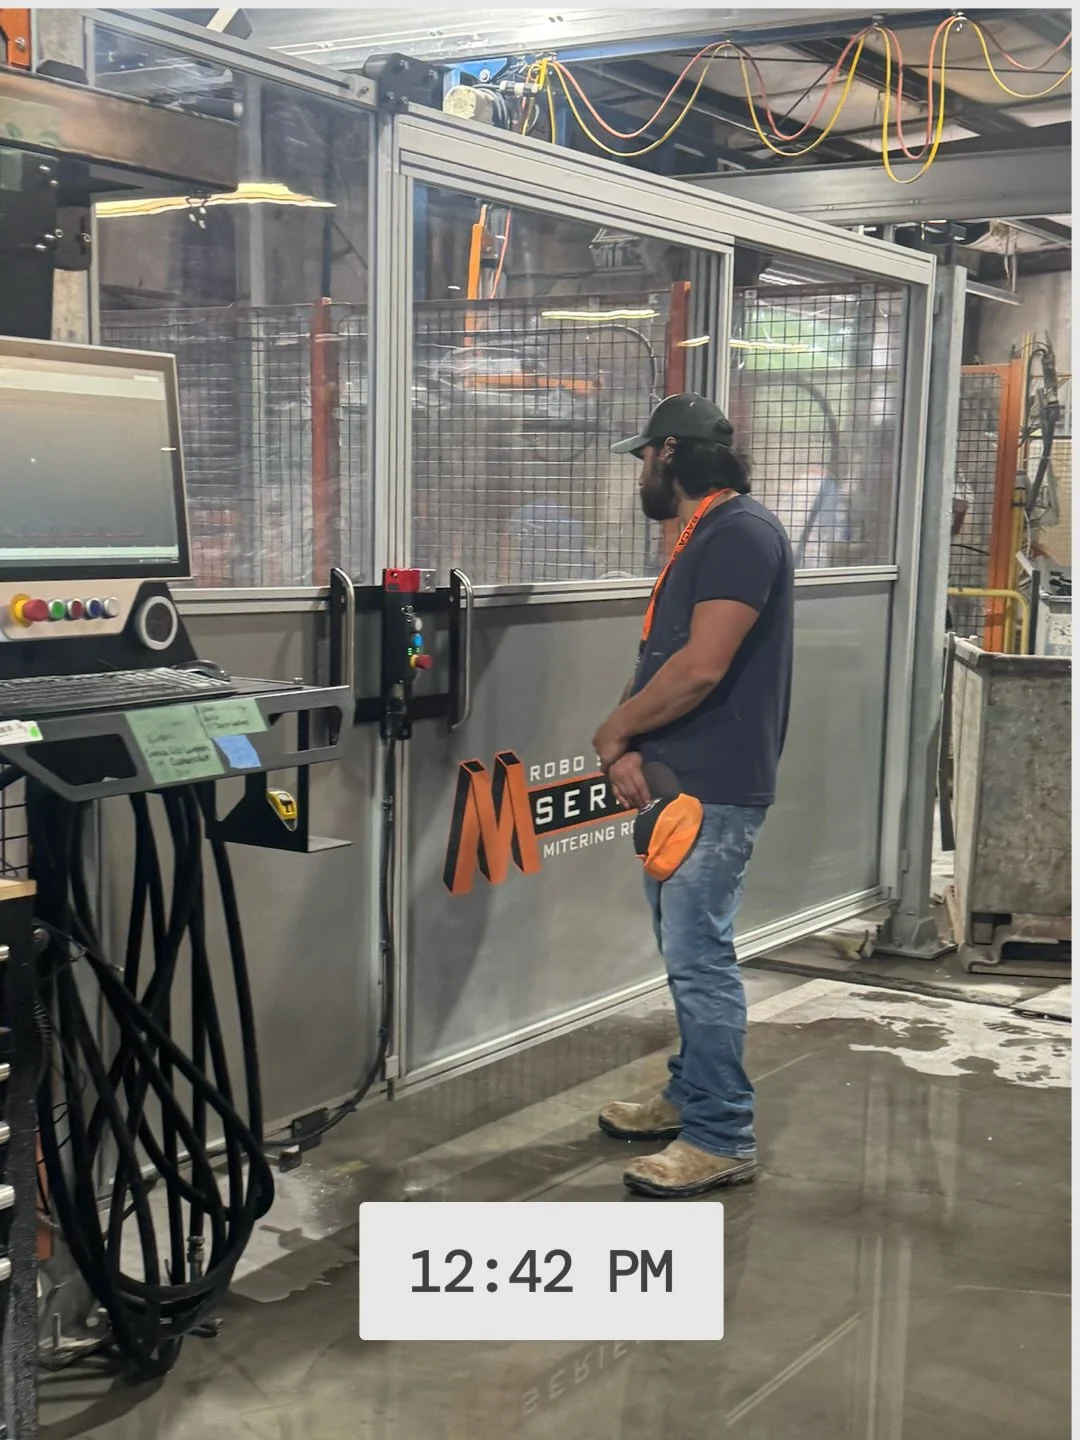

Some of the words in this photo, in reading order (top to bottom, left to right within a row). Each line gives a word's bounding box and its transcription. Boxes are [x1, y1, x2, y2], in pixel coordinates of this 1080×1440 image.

[530, 755, 585, 781] ROBO
[535, 783, 620, 826] SER
[543, 825, 616, 859] MITERING
